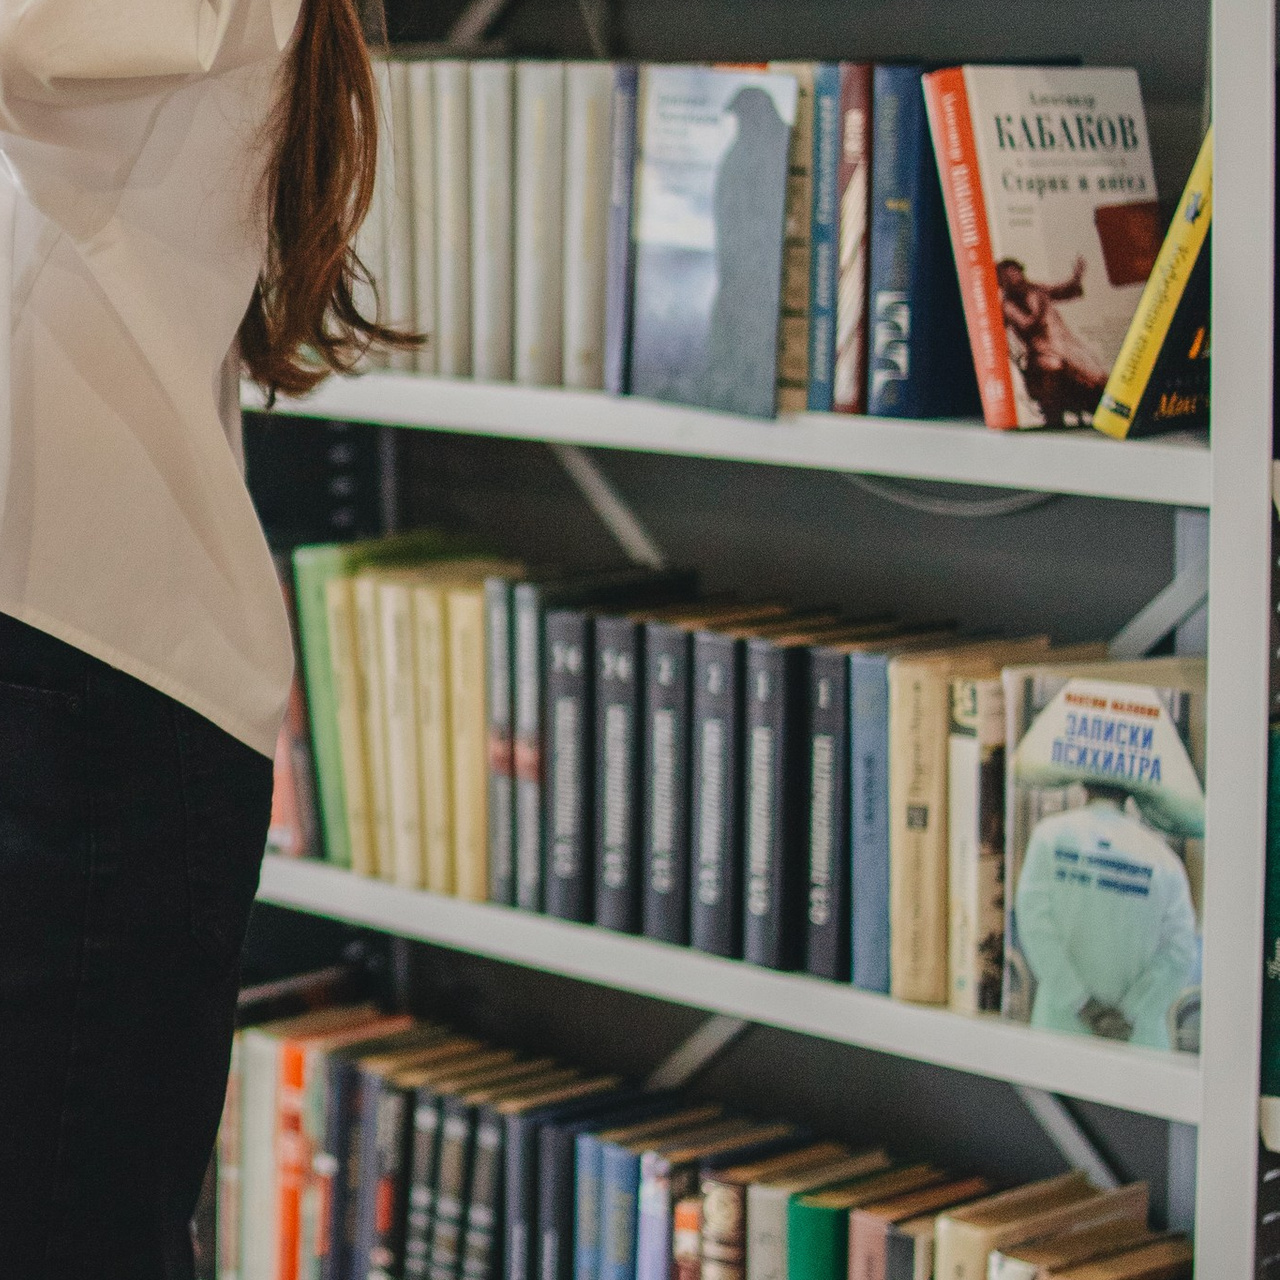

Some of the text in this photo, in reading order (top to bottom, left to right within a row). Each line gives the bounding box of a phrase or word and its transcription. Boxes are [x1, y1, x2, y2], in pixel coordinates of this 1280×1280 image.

[994, 114, 1138, 152] КАБАКОВ
[1002, 171, 1068, 199] Старик
[1066, 714, 1154, 750] ЗАПИСКИ
[1051, 740, 1161, 784] ПСИХИАТРА
